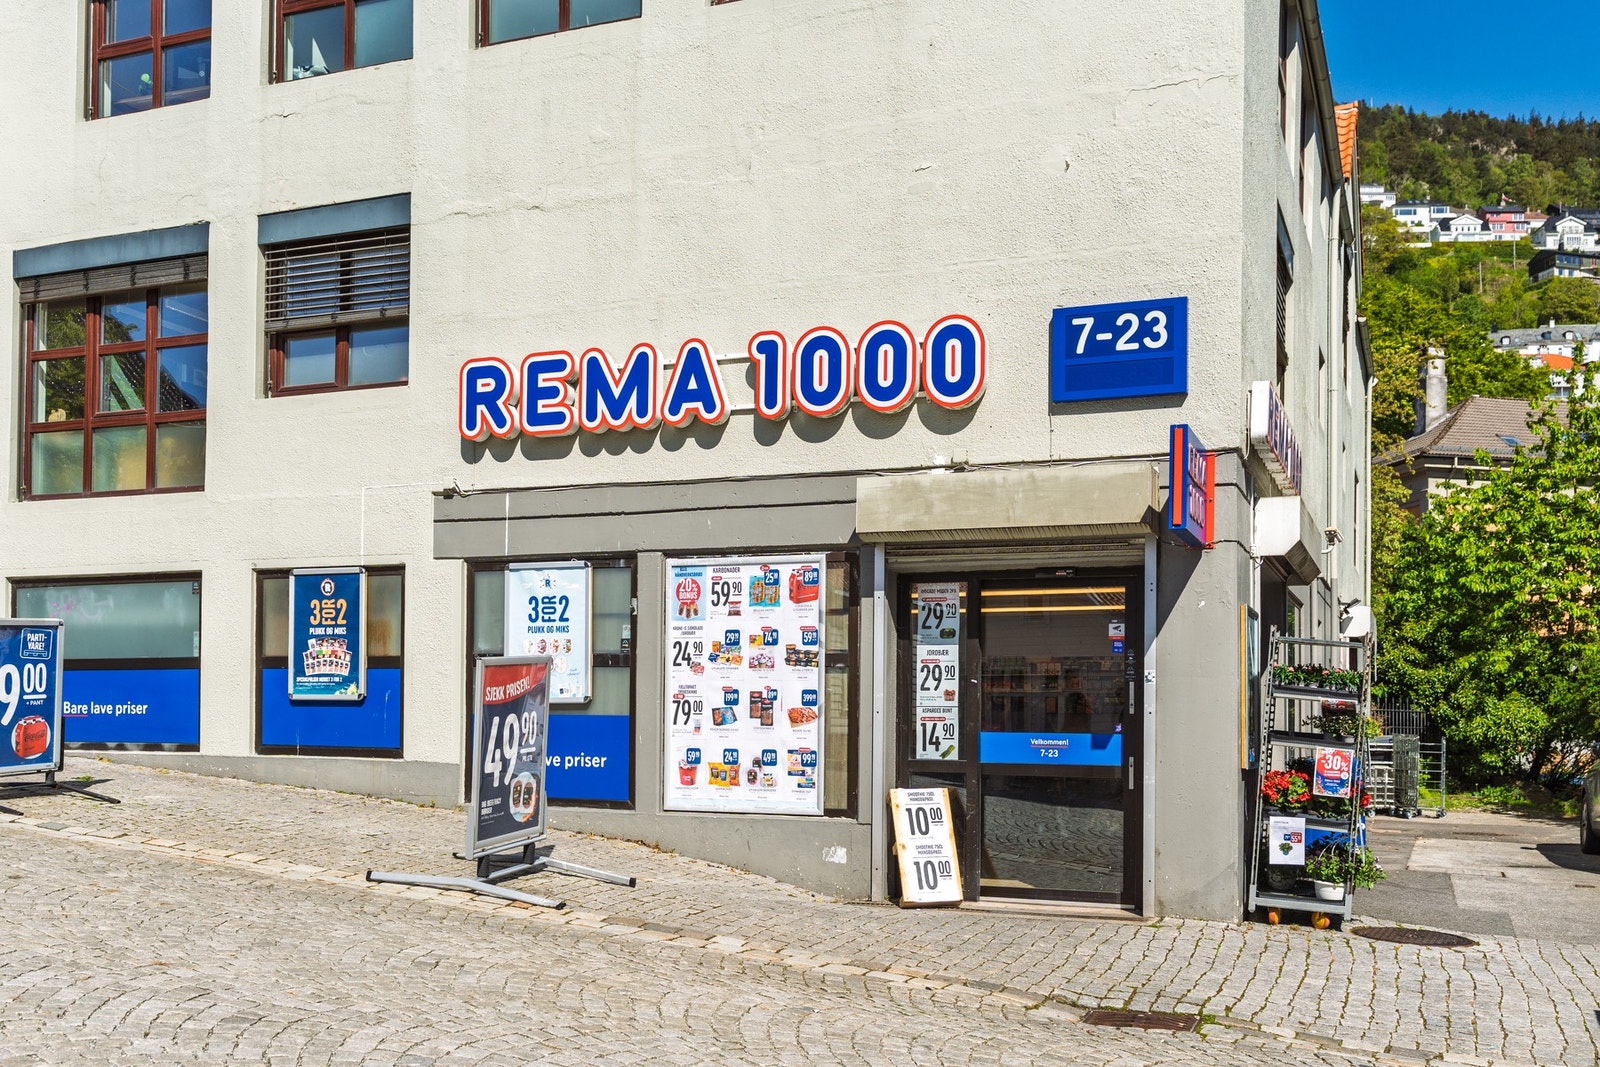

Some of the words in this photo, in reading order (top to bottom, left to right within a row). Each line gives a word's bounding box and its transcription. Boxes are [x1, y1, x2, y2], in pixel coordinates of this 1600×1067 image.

[1072, 312, 1169, 355] 7-23
[459, 339, 728, 442] REMA
[749, 313, 986, 420] 1000
[679, 591, 697, 599] BONUS
[711, 581, 731, 607] 59
[732, 581, 742, 593] 90
[309, 599, 320, 625] 3
[322, 599, 335, 625] FOR
[337, 599, 347, 625] 2
[528, 596, 539, 623] 3
[541, 595, 557, 623] FOR
[558, 595, 570, 623] 2
[922, 603, 944, 630] 29
[945, 603, 957, 616] 90
[27, 633, 47, 642] PARTI-
[527, 626, 545, 634] PLUKK
[555, 625, 570, 633] MIKS
[28, 641, 45, 651] VARE!
[673, 641, 692, 667] 24
[693, 641, 703, 653] 90
[23, 663, 47, 693] 00
[485, 686, 505, 701] SJEKK
[506, 675, 531, 699] PRISEN!
[920, 664, 942, 691] 29
[944, 665, 956, 678] 90
[63, 701, 88, 714] Bare
[91, 701, 113, 714] lave
[115, 701, 149, 717] priser
[672, 700, 691, 726] 79
[693, 700, 703, 713] 00
[484, 713, 520, 788] 49
[521, 710, 537, 746] 90
[920, 722, 941, 752] 14
[942, 723, 955, 737] 90
[565, 752, 607, 770] priser
[1040, 749, 1059, 757] 7-23
[905, 807, 930, 836] 10
[929, 807, 943, 821] 00
[913, 860, 938, 890] 10
[937, 860, 952, 874] 00
